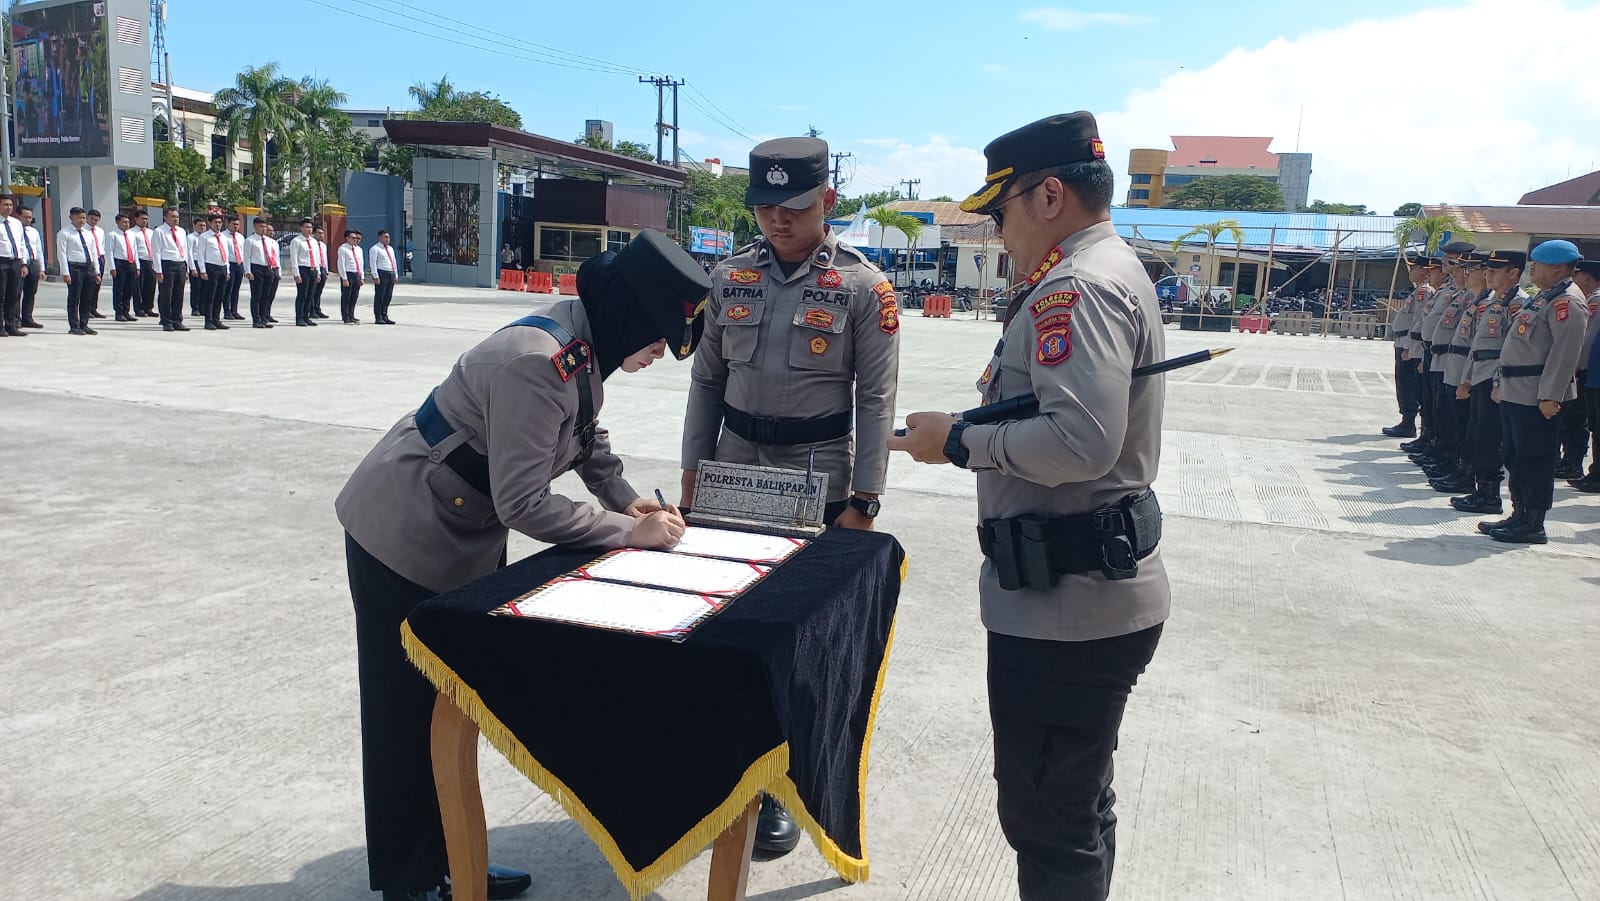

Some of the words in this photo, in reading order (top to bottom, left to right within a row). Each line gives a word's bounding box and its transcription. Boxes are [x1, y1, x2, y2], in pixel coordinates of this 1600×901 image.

[722, 287, 763, 299] SATRIA
[802, 289, 850, 306] POLRI
[1034, 293, 1073, 310] POLRESTA
[704, 472, 753, 488] POLRESTA
